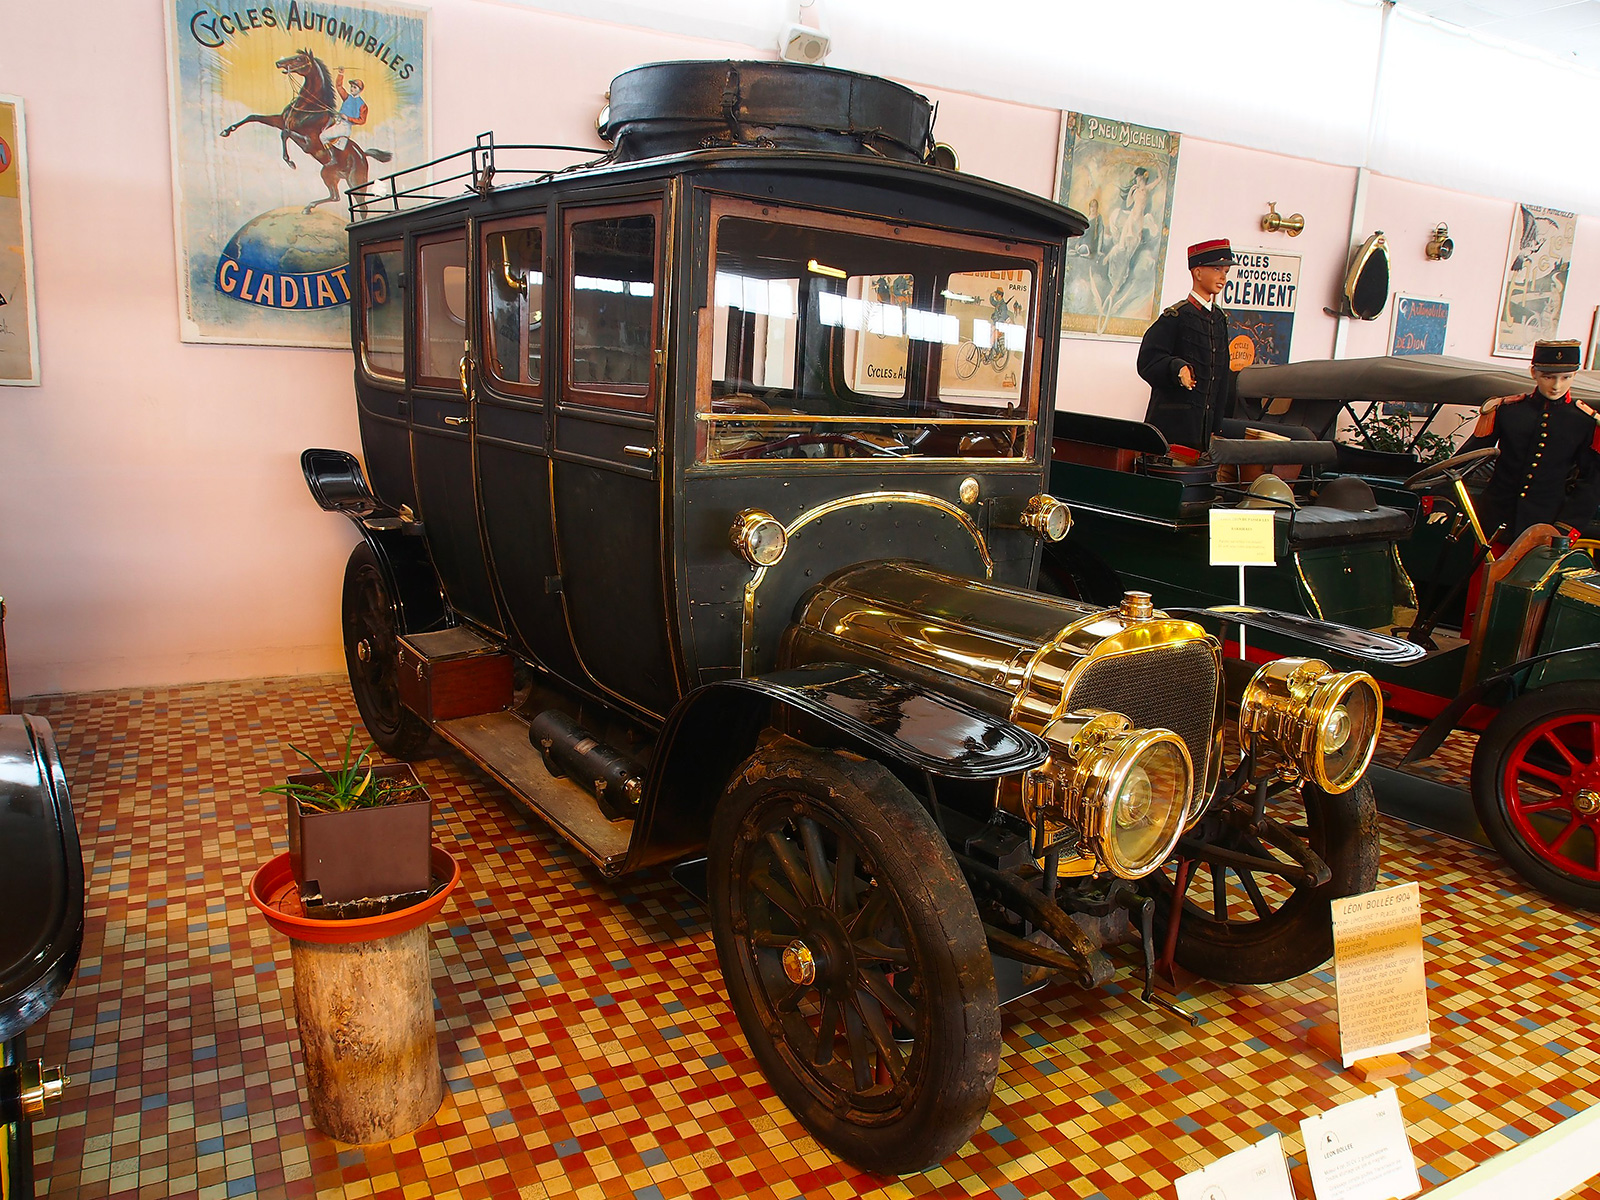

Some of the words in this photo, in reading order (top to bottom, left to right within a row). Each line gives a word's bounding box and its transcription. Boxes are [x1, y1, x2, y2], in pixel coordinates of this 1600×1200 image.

[190, 7, 277, 48] CYCLES
[286, 0, 414, 80] AUTOMOBILES
[1088, 118, 1118, 139] PNEU
[1118, 124, 1166, 150] MICHELIN
[219, 259, 350, 308] GLADIAT
[1237, 269, 1292, 282] MOTOCYCLES
[1008, 283, 1027, 292] PARIS
[1224, 280, 1296, 307] CLÉMENT
[1234, 342, 1249, 350] CYCLES
[1404, 332, 1429, 350] DION
[867, 364, 893, 379] CYCLES
[1342, 901, 1362, 914] LÉON
[1365, 895, 1394, 909] BOLLÉE
[1395, 892, 1410, 902] 1904
